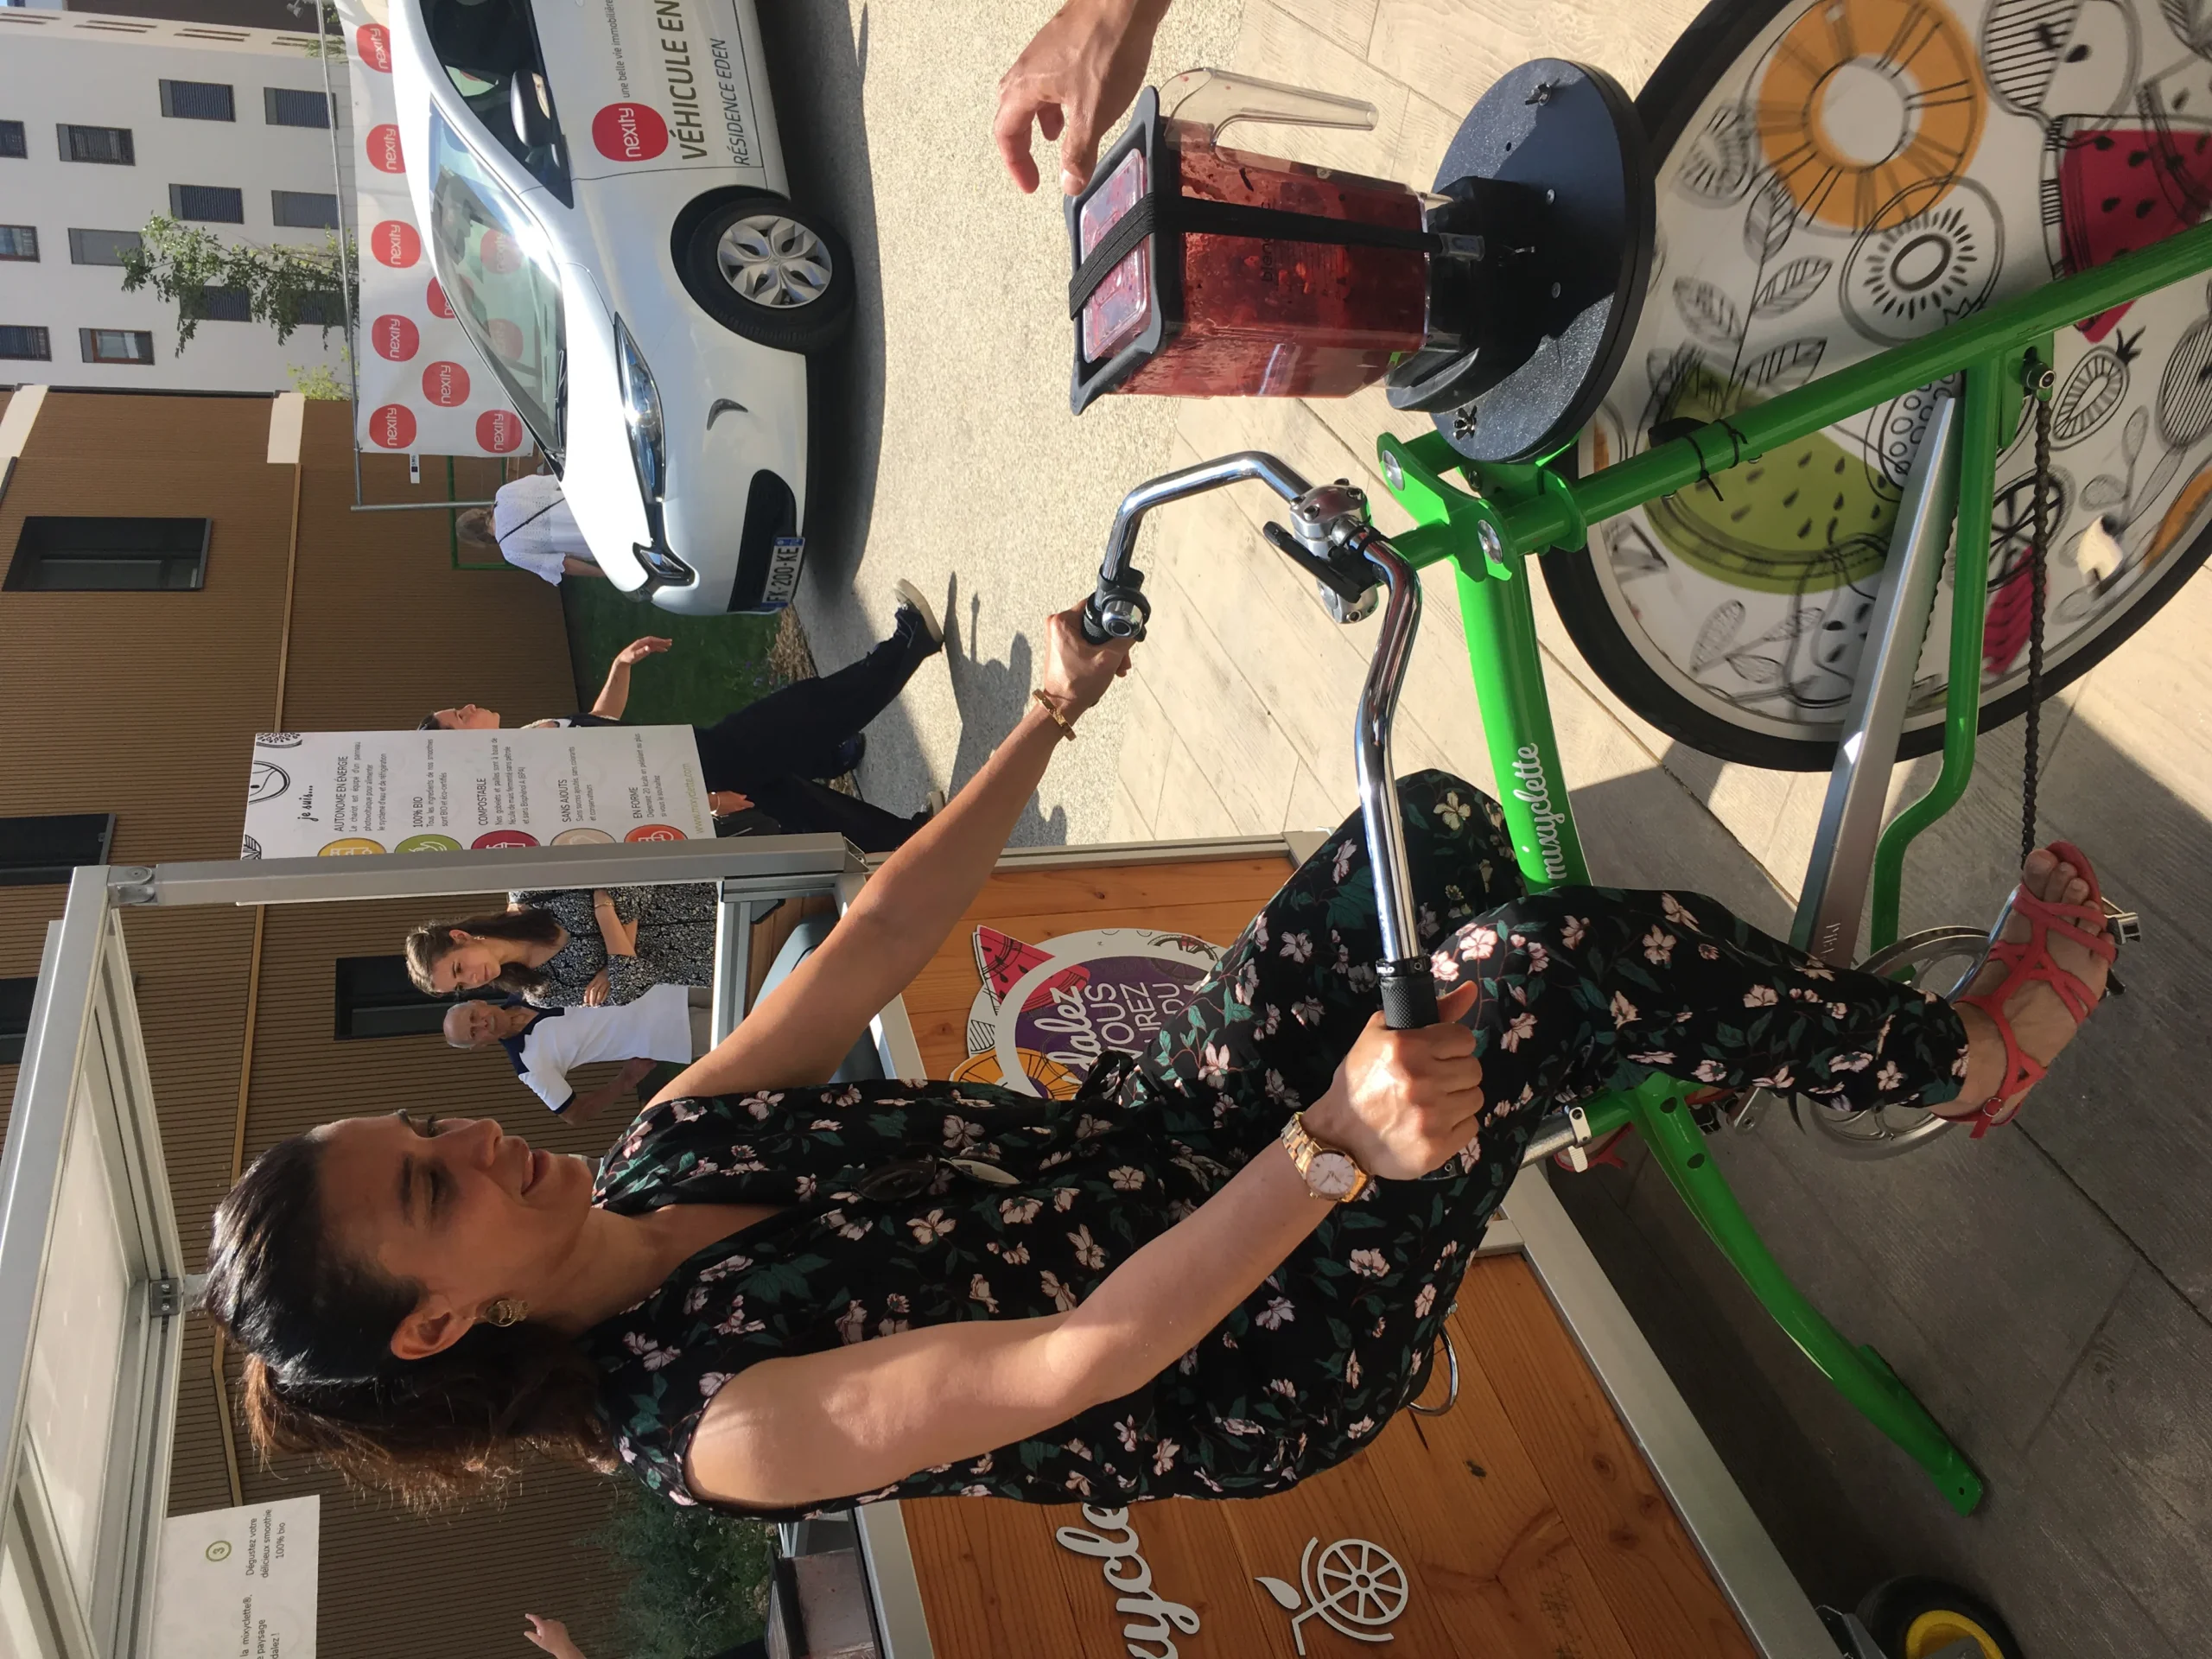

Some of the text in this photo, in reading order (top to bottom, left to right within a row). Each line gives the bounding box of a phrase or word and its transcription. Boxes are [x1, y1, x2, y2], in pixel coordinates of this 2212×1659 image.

[370, 28, 389, 70] nexity
[611, 48, 622, 60] vie
[614, 60, 627, 81] belle
[620, 83, 630, 99] une
[660, 39, 708, 160] VÉHICULE
[709, 38, 750, 166] RÉSIDENCE EDEN
[385, 128, 397, 171] nexity
[617, 108, 641, 158] nexity
[389, 225, 401, 265] nexity
[389, 318, 400, 359] nexity
[439, 365, 452, 404] nexity
[385, 407, 397, 446] nexity
[492, 413, 504, 451] nexity
[766, 547, 798, 602] FK-200-KE
[633, 733, 643, 742] plus
[364, 764, 373, 785] alimenter
[365, 785, 374, 796] pour
[334, 756, 348, 832] AUTONOME EN ÉNERGIE
[476, 778, 488, 826] COMPOSTABLE
[493, 794, 504, 813] gobelets
[557, 779, 572, 823] SANS AJOUTS
[574, 795, 582, 810] sucres
[585, 785, 596, 816] conservateurs
[628, 786, 643, 819] EN FORME
[658, 801, 666, 812] vous
[681, 763, 704, 834] www.mixyclette.com
[1512, 743, 1567, 880] mixyclette
[297, 812, 319, 822] je
[349, 805, 359, 822] chariot
[412, 797, 423, 828] 100% BIO
[494, 816, 503, 825] Nos
[575, 810, 583, 822] Sans
[245, 1518, 257, 1576] Dégustez votre
[260, 1510, 272, 1578] délicieux smoothie
[275, 1522, 286, 1559] 100% bio
[239, 1649, 250, 1657] la
[257, 1619, 268, 1654] paysage
[270, 1637, 279, 1659] dalez
